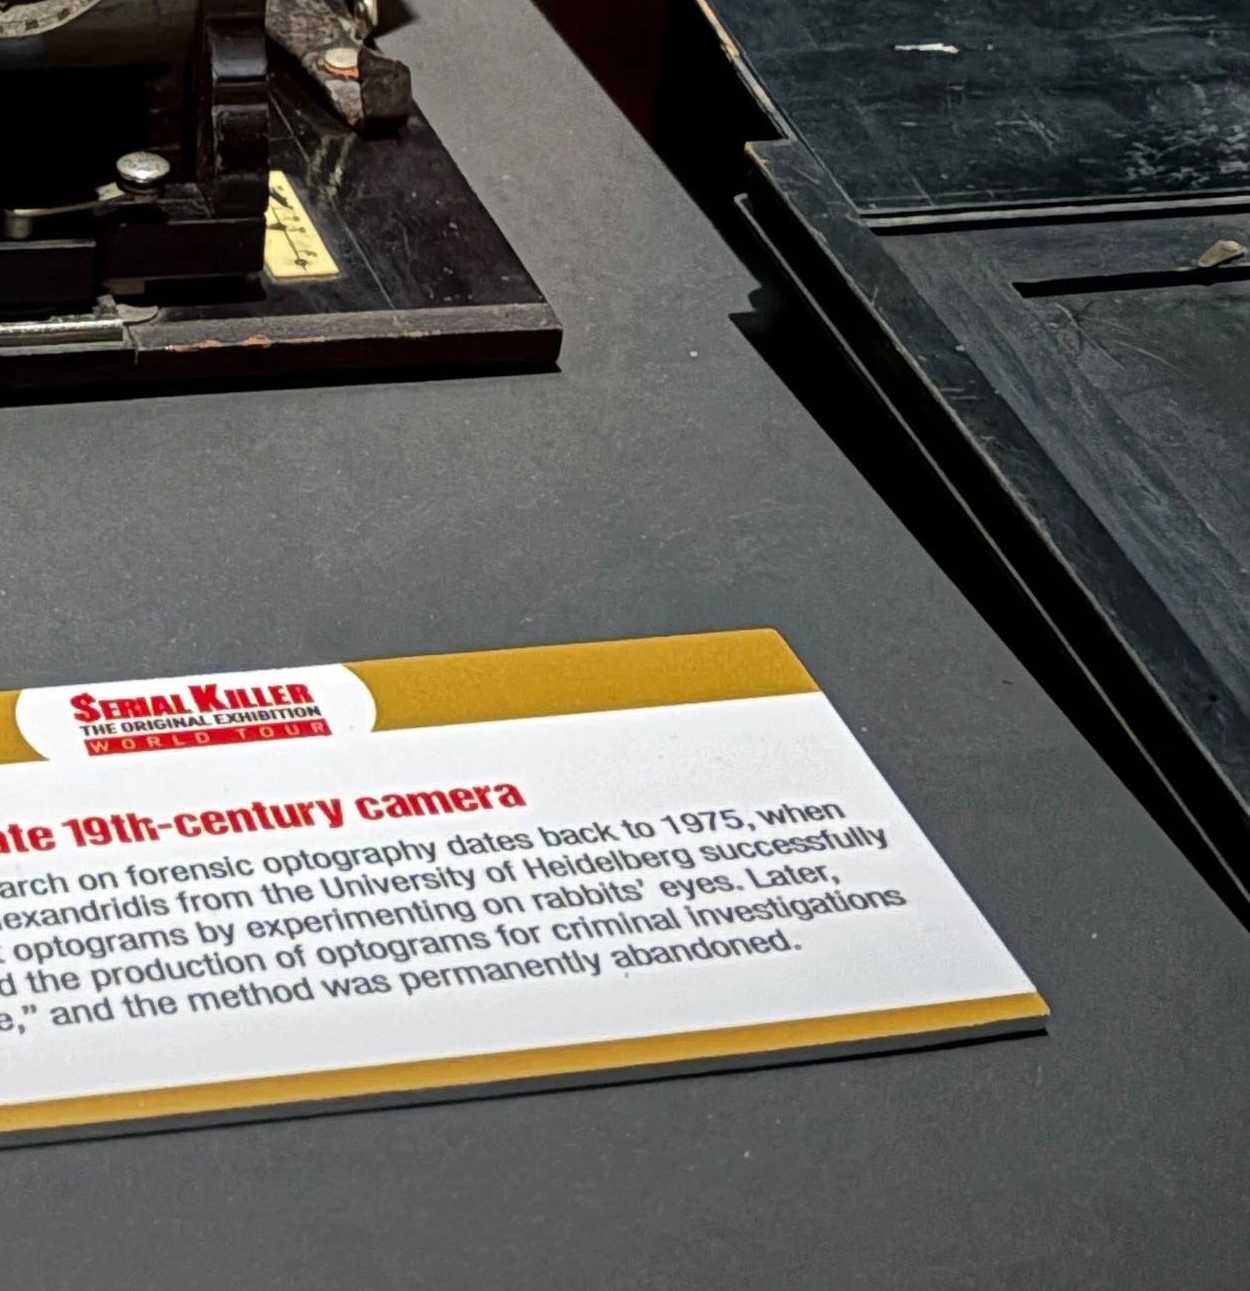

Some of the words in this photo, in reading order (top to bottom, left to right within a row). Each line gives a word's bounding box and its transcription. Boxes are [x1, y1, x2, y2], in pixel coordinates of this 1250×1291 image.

[70, 692, 191, 722] SERIAL
[187, 683, 316, 712] KILLER
[79, 722, 118, 737] THE
[121, 714, 212, 732] ORIGINAL
[215, 705, 323, 725] EXHIBITION
[89, 732, 211, 753] WORLD
[236, 722, 327, 740] TOUR
[61, 797, 345, 848] 19th-century
[354, 783, 528, 821] camera
[77, 871, 119, 891] on
[125, 855, 255, 887] forensic
[262, 839, 437, 877] optography
[446, 832, 535, 857] dates
[537, 821, 621, 848] back
[620, 819, 656, 840] to
[660, 808, 757, 835] 1975,
[755, 803, 847, 826] when
[175, 890, 254, 914] from
[260, 882, 315, 905] the
[319, 866, 476, 899] University
[485, 860, 517, 884] of
[521, 847, 696, 880] Heidelberg
[698, 825, 888, 863] successfully
[12, 927, 190, 966] optograms
[195, 921, 235, 947] by
[246, 899, 477, 941] experimenting
[482, 895, 526, 916] on
[659, 875, 745, 901] eyes.
[744, 864, 841, 889] Later,
[24, 969, 81, 994] the
[90, 951, 268, 993] production
[275, 943, 307, 969] of
[315, 931, 492, 968] optograms
[495, 923, 541, 947] for
[551, 906, 682, 942] criminal
[683, 889, 908, 928] investigations
[49, 996, 115, 1026] and
[121, 993, 179, 1019] the
[187, 976, 315, 1013] method
[320, 974, 393, 998] was
[398, 949, 602, 997] permanently
[610, 928, 802, 969] abandoned.
